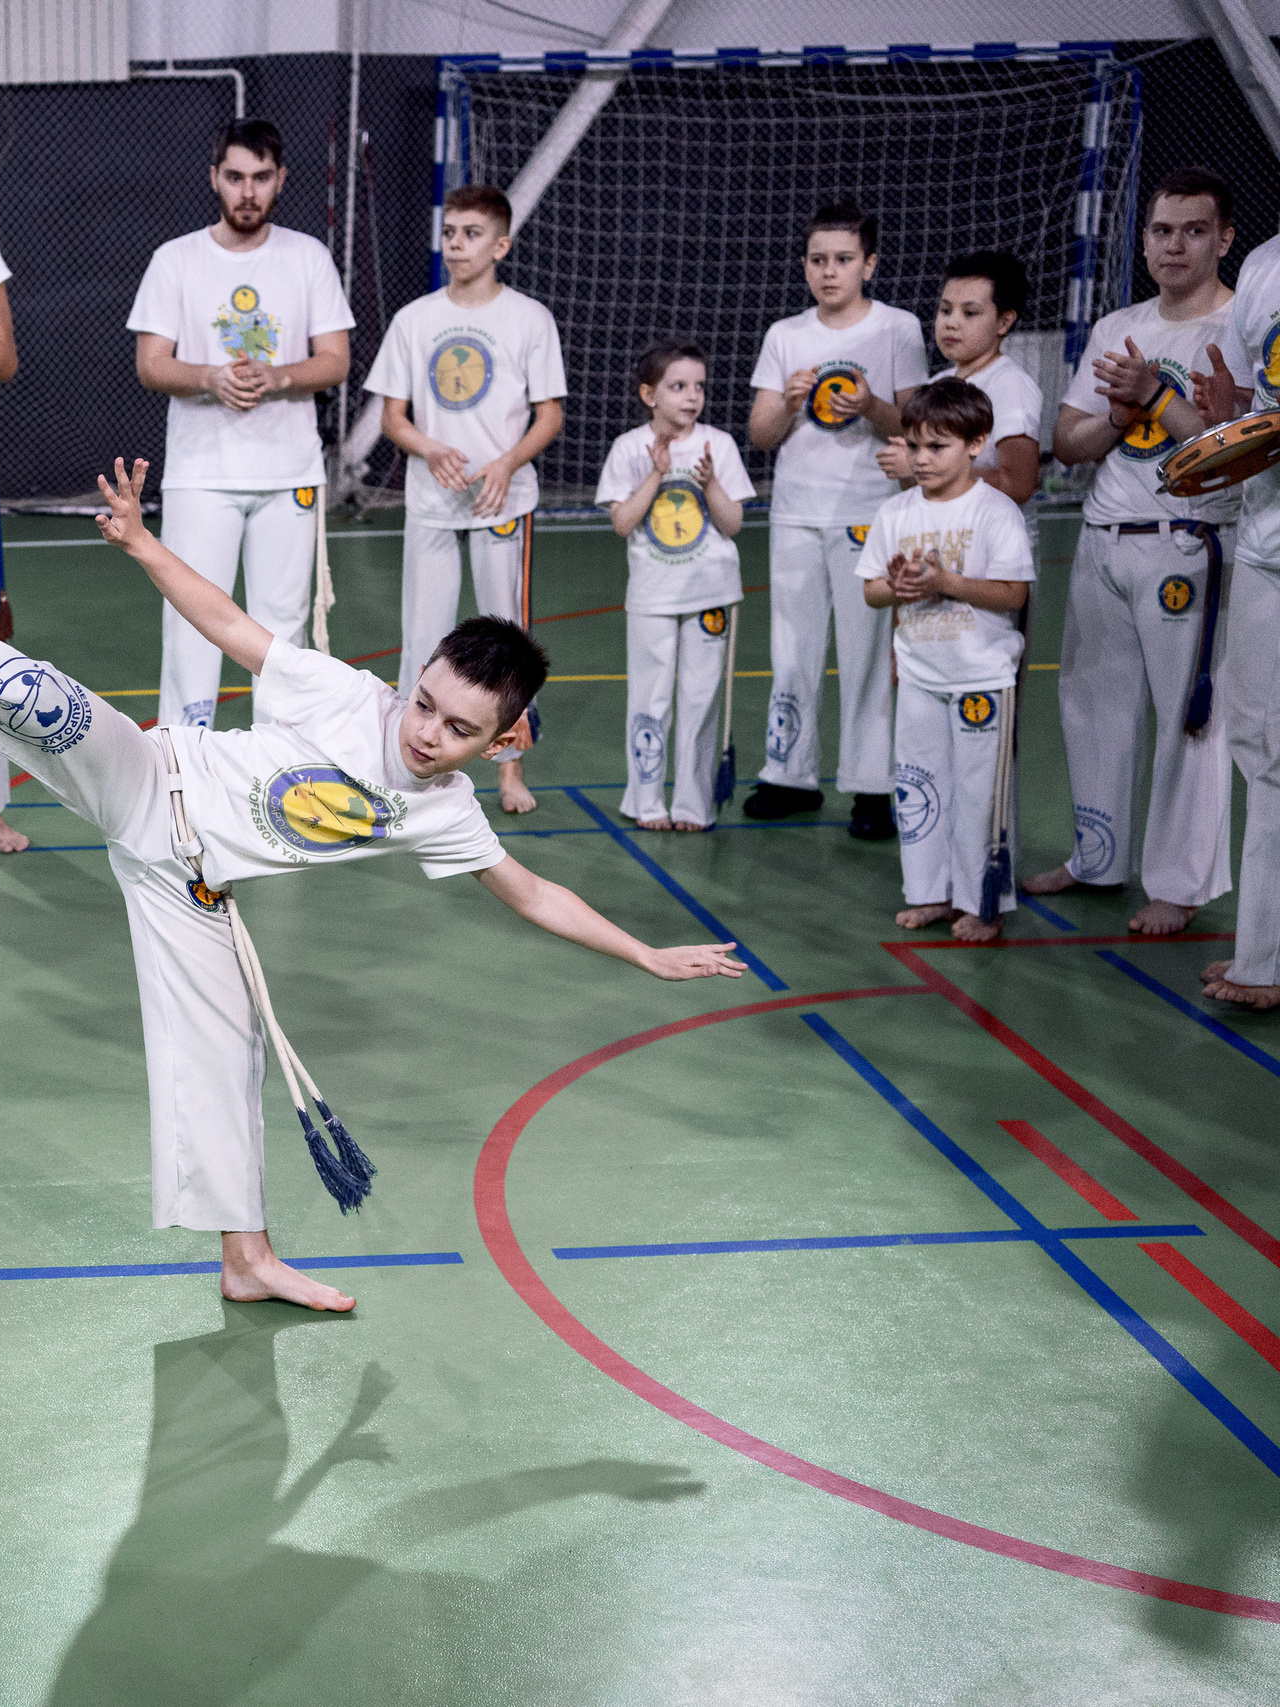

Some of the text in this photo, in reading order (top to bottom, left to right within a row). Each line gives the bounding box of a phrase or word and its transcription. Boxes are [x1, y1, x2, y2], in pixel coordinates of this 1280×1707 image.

[64, 694, 81, 735] GRUPO
[74, 684, 92, 732] MESTRE
[248, 775, 279, 849] PROFESSOR
[270, 795, 306, 847] CAPOEIRA
